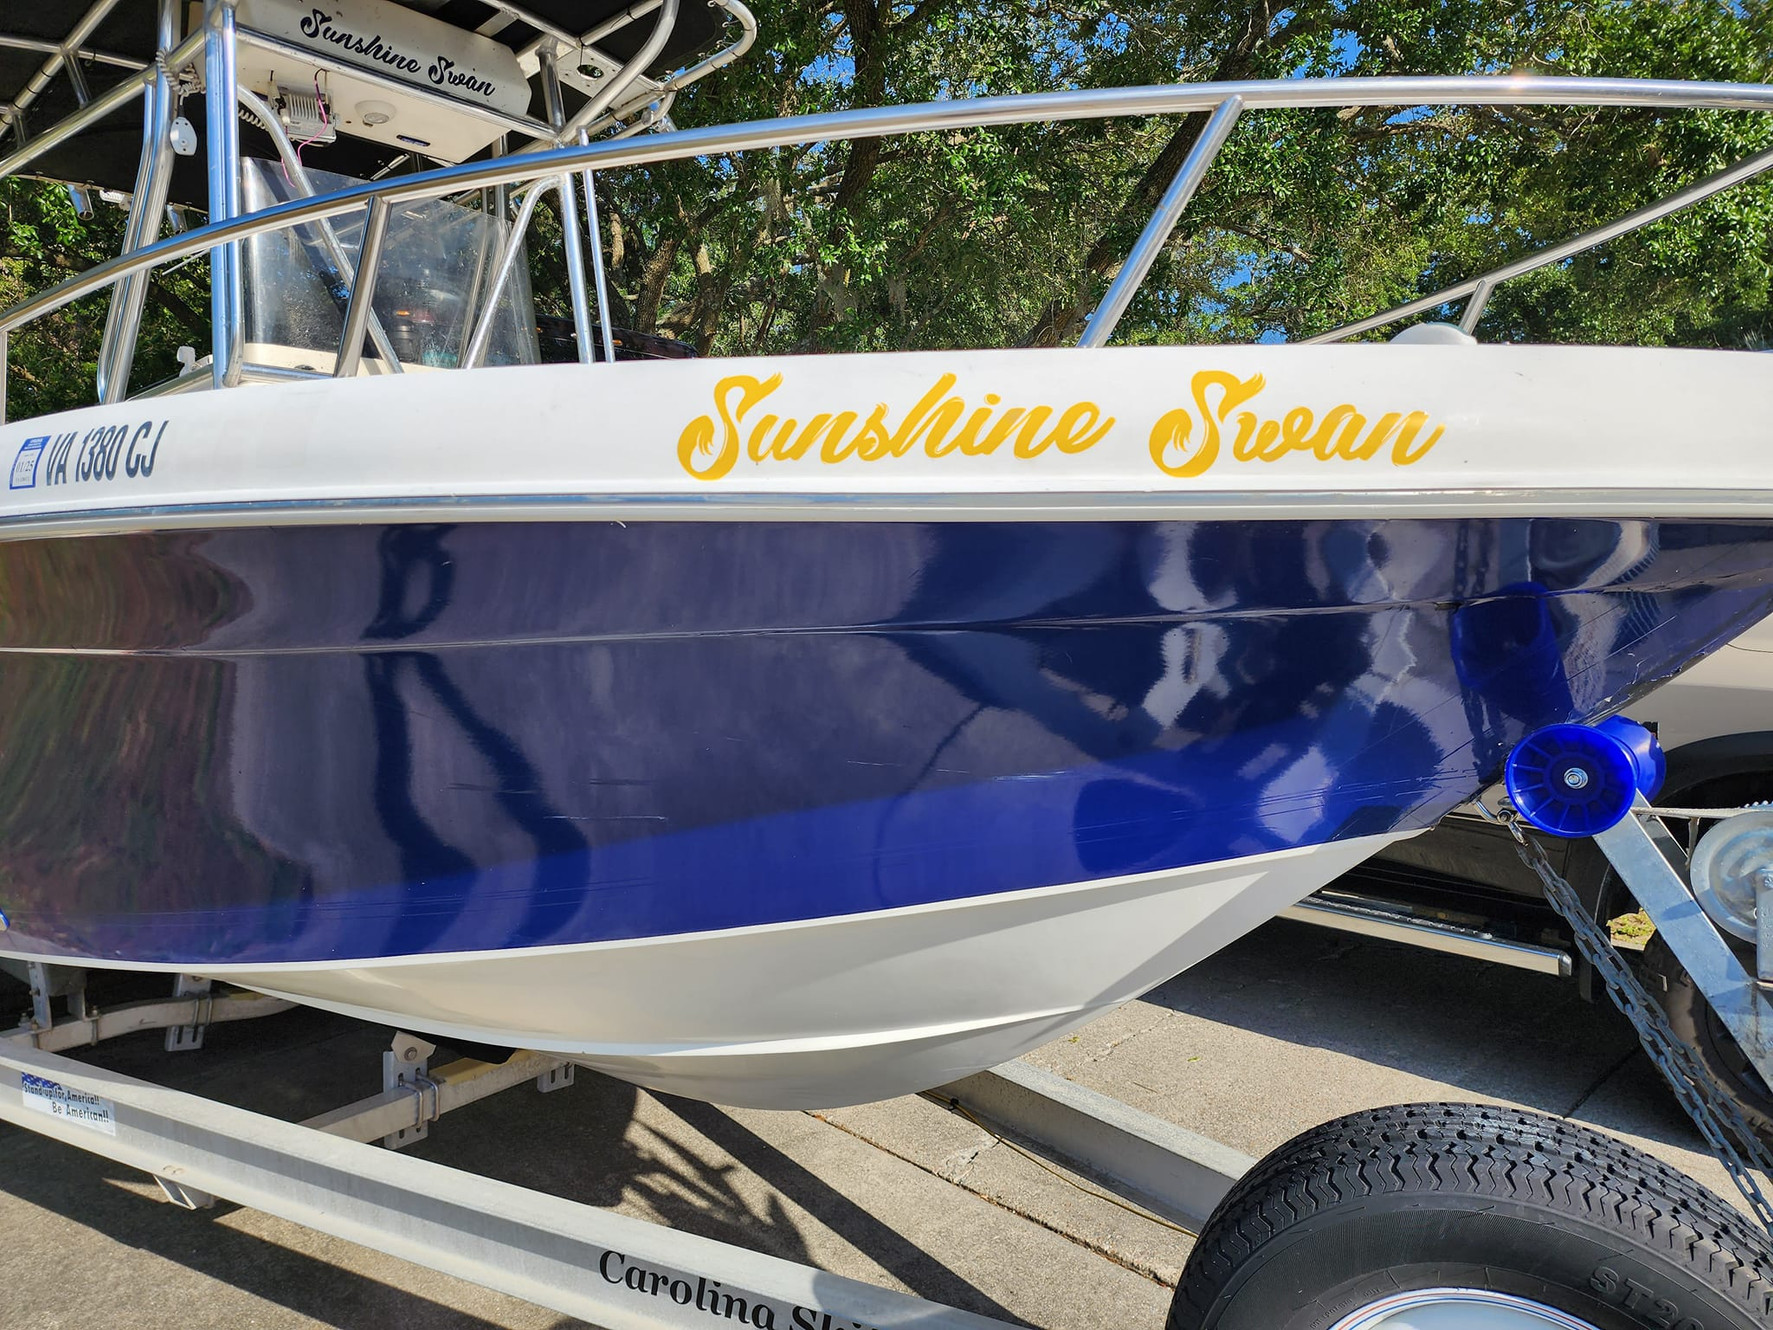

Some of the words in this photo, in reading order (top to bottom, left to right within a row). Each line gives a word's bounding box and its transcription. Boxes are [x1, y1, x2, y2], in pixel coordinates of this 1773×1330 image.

[300, 8, 421, 74] Sunshine
[428, 55, 495, 97] Swan
[46, 431, 79, 486] VA
[75, 424, 129, 483] 1380
[125, 420, 170, 479] CJ
[676, 372, 1115, 481] Sunshine
[1149, 370, 1445, 478] Swan
[23, 1082, 44, 1096] Stand
[67, 1090, 100, 1106] America!!
[52, 1101, 62, 1115] Be
[66, 1104, 109, 1124] American!!
[599, 1249, 775, 1330] Carolina
